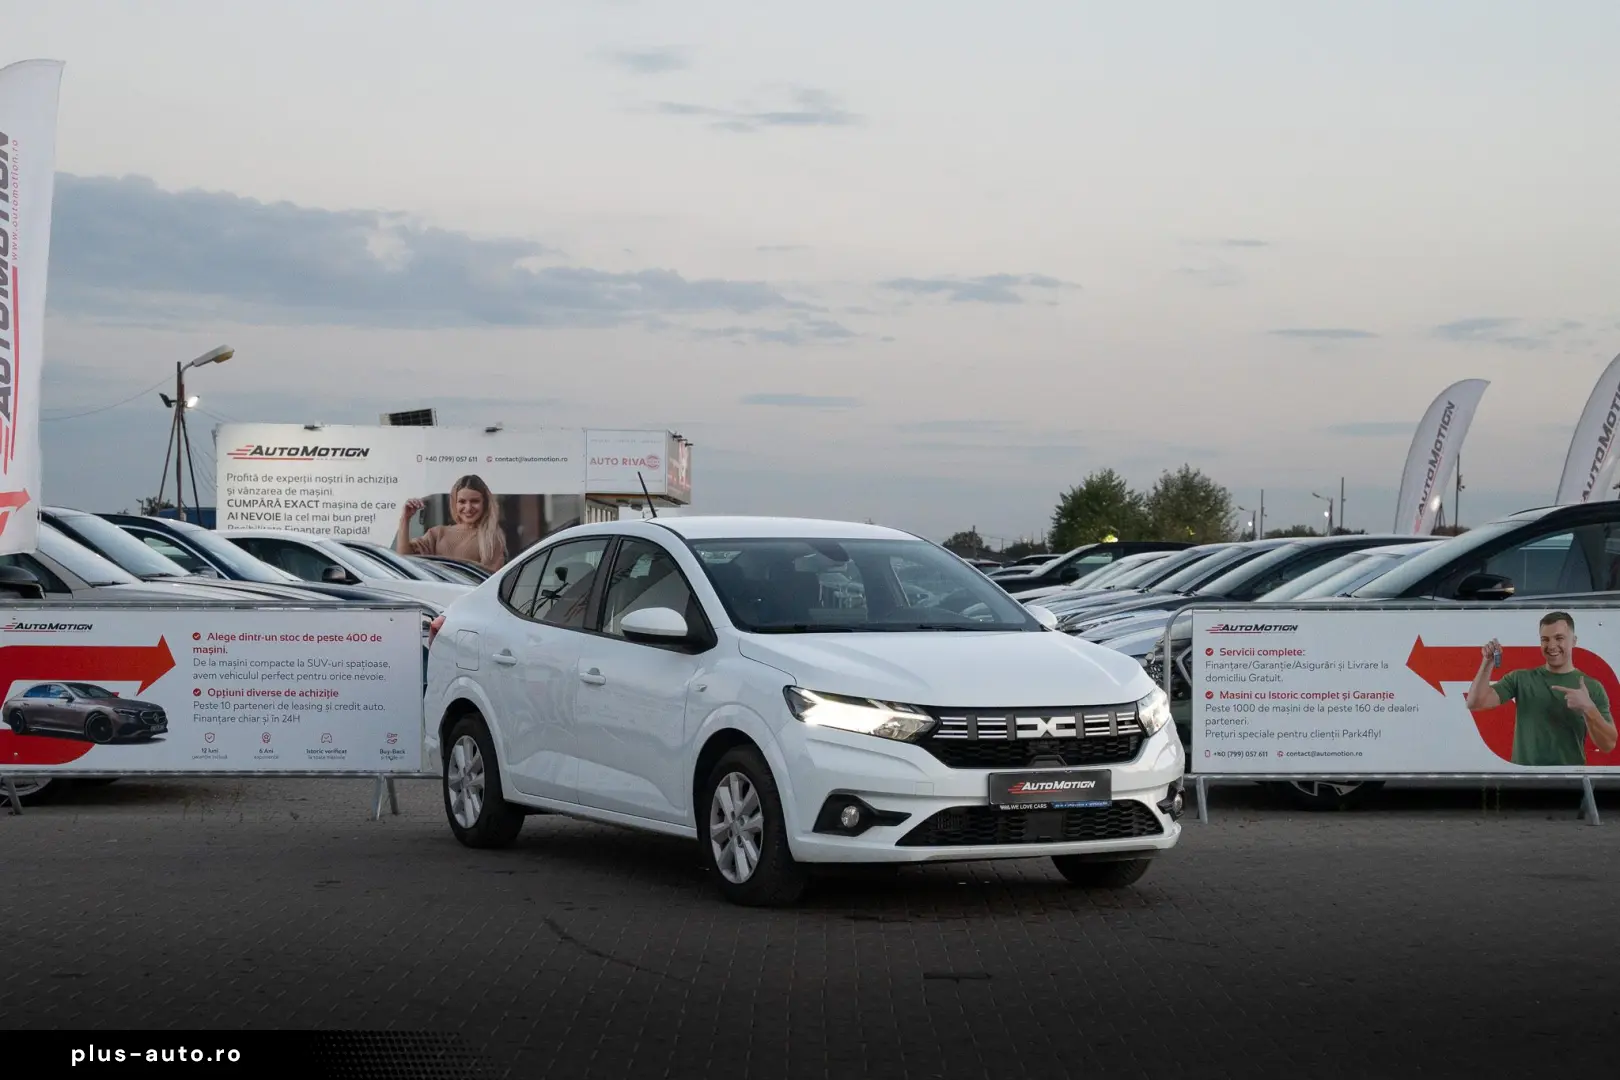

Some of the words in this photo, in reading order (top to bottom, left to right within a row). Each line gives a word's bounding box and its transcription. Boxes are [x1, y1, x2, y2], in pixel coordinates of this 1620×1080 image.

[590, 457, 618, 465] AUTO
[622, 458, 647, 466] RIVA
[227, 473, 258, 482] Profită
[262, 474, 273, 482] de
[276, 474, 312, 484] experții
[315, 475, 343, 484] noștri
[346, 475, 354, 483] în
[357, 475, 398, 485] achiziția
[227, 487, 235, 496] și
[238, 486, 282, 494] vânzarea
[285, 487, 297, 496] de
[300, 488, 334, 498] mașini.
[227, 499, 282, 508] CUMPĂRĂ
[284, 500, 320, 508] EXACT
[322, 501, 358, 510] mașina
[361, 501, 372, 509] de
[227, 512, 238, 520] AI
[241, 512, 281, 521] NEVOIE
[284, 513, 292, 521] la
[296, 513, 309, 521] cel
[333, 514, 351, 522] bun
[354, 514, 376, 524] preț!
[207, 633, 236, 643] Alege
[239, 633, 277, 641] dintr-un
[317, 635, 344, 643] peste
[346, 634, 367, 642] 400
[370, 634, 382, 642] de
[193, 645, 228, 655] mașini.
[1220, 648, 1255, 656] Servicii
[1257, 648, 1305, 657] complete:
[194, 658, 206, 666] De
[209, 658, 216, 666] la
[219, 659, 247, 669] mașini
[250, 660, 294, 669] compacte
[297, 659, 304, 667] la
[308, 659, 343, 668] SUV-uri
[346, 660, 390, 670] spațioase,
[219, 671, 258, 680] vehiculul
[261, 671, 294, 682] perfect
[296, 673, 327, 682] pentru
[330, 672, 352, 680] orice
[354, 672, 386, 680] nevoie.
[1205, 673, 1246, 682] domiciliu
[1249, 673, 1283, 682] Gratuit.
[208, 688, 244, 698] Opțiuni
[246, 688, 282, 697] diverse
[284, 688, 296, 697] de
[299, 689, 339, 699] achiziție
[1269, 691, 1298, 699] Istoric
[1300, 691, 1340, 701] complet
[1342, 691, 1350, 701] și
[1353, 691, 1394, 701] Garanție
[194, 701, 218, 709] Peste
[220, 701, 231, 709] 10
[233, 701, 275, 712] parteneri
[277, 701, 289, 710] de
[292, 701, 322, 712] leasing
[325, 702, 332, 712] și
[334, 702, 361, 711] credit
[1205, 704, 1230, 712] Peste
[1233, 704, 1255, 712] 1000
[1258, 704, 1270, 712] de
[1272, 704, 1300, 715] mașini
[1303, 704, 1315, 712] de
[1318, 704, 1324, 712] la
[1328, 704, 1352, 715] peste
[1355, 704, 1370, 712] 160
[1373, 704, 1385, 712] de
[1388, 704, 1419, 712] dealeri
[194, 714, 236, 725] Finanțare
[237, 714, 260, 722] chiar
[262, 714, 269, 725] și
[271, 714, 279, 723] în
[282, 714, 300, 723] 24H
[1205, 717, 1249, 727] parteneri.
[1205, 729, 1236, 740] Prețuri
[1237, 730, 1274, 740] speciale
[1277, 731, 1308, 740] pentru
[1310, 730, 1340, 740] clienții
[1342, 729, 1381, 740] Park4fly!
